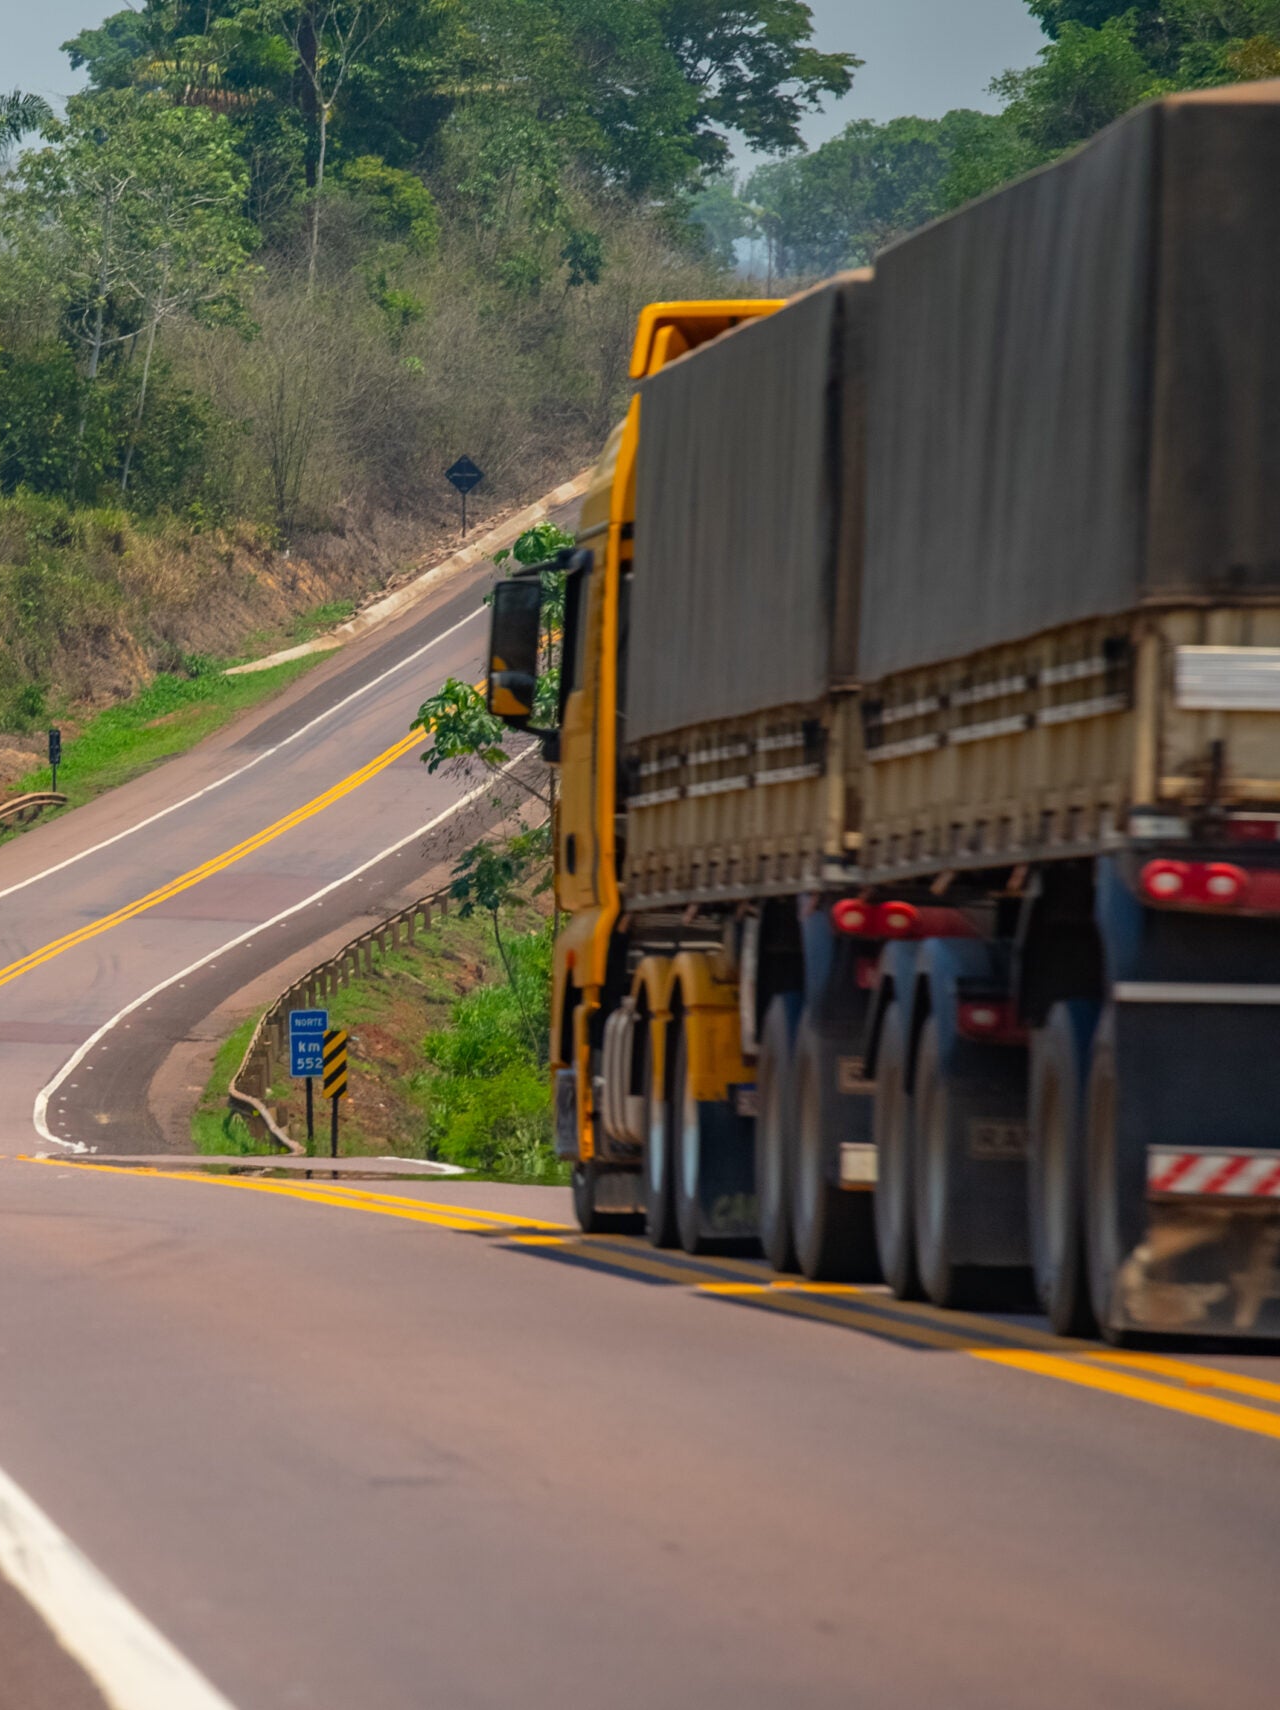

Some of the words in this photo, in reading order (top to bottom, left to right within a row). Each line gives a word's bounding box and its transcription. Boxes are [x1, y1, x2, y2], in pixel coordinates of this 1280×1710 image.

[295, 1017, 323, 1027] NORTE
[298, 1041, 320, 1052] km
[297, 1057, 323, 1070] 552
